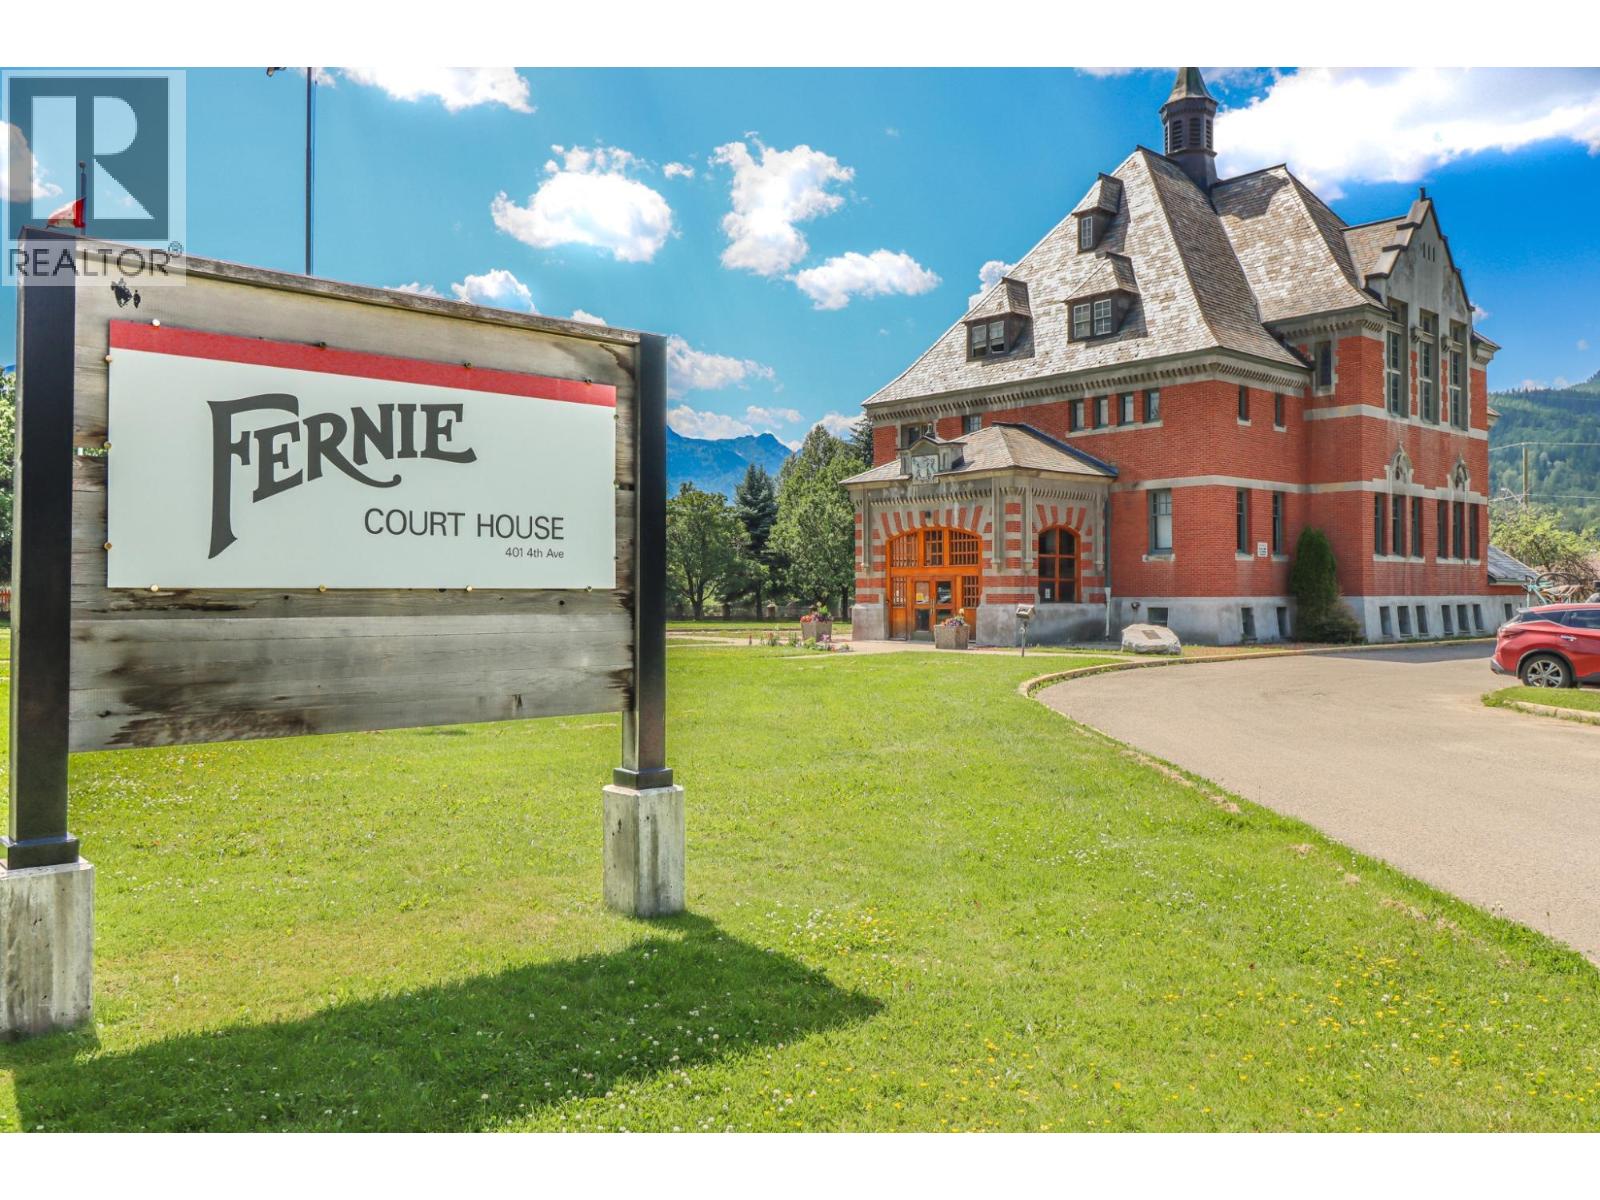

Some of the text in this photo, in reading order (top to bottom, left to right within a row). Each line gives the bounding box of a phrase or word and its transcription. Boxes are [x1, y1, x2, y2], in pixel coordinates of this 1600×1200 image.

[206, 393, 478, 560] FERNIE
[364, 507, 565, 541] COURT HOUSE
[504, 546, 565, 559] 401 4th Ave
